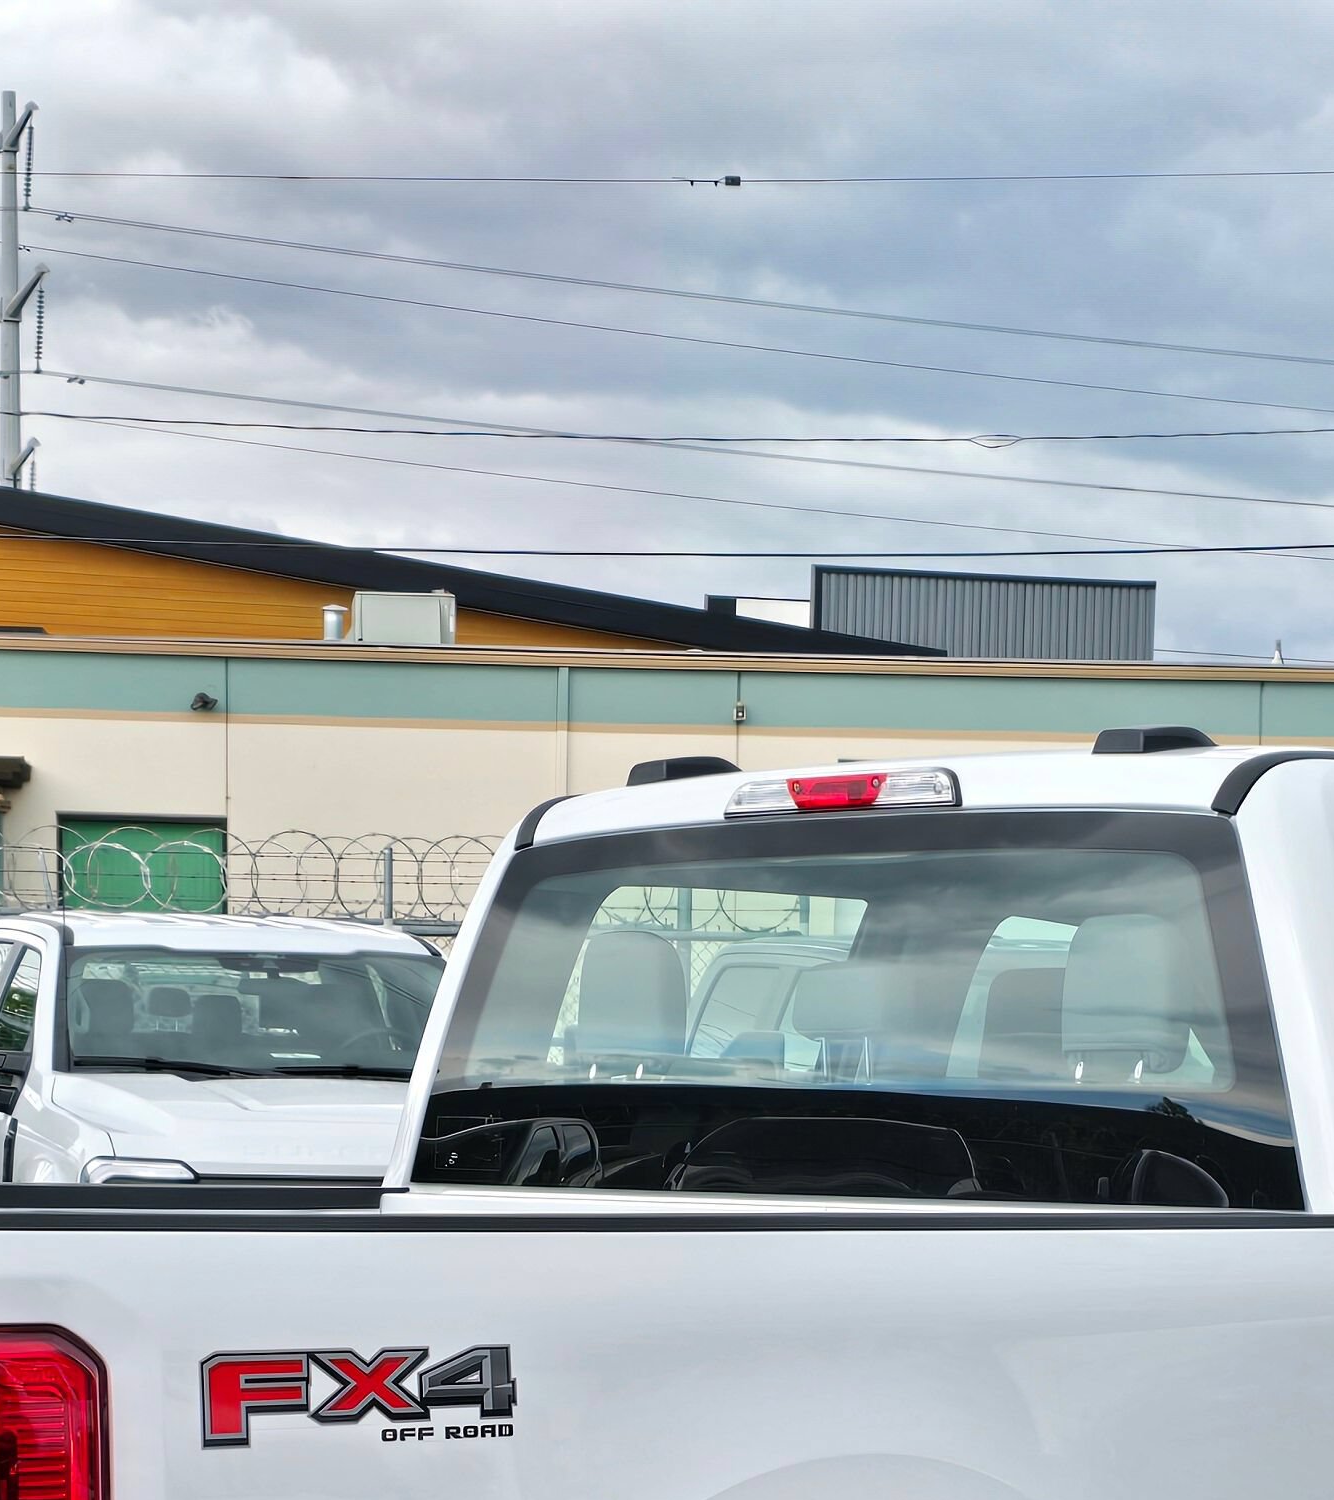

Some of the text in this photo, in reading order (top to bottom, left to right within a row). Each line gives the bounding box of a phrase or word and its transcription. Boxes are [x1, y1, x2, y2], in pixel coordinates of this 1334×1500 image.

[199, 1343, 518, 1449] FX4
[381, 1423, 515, 1442] OFF ROAD
